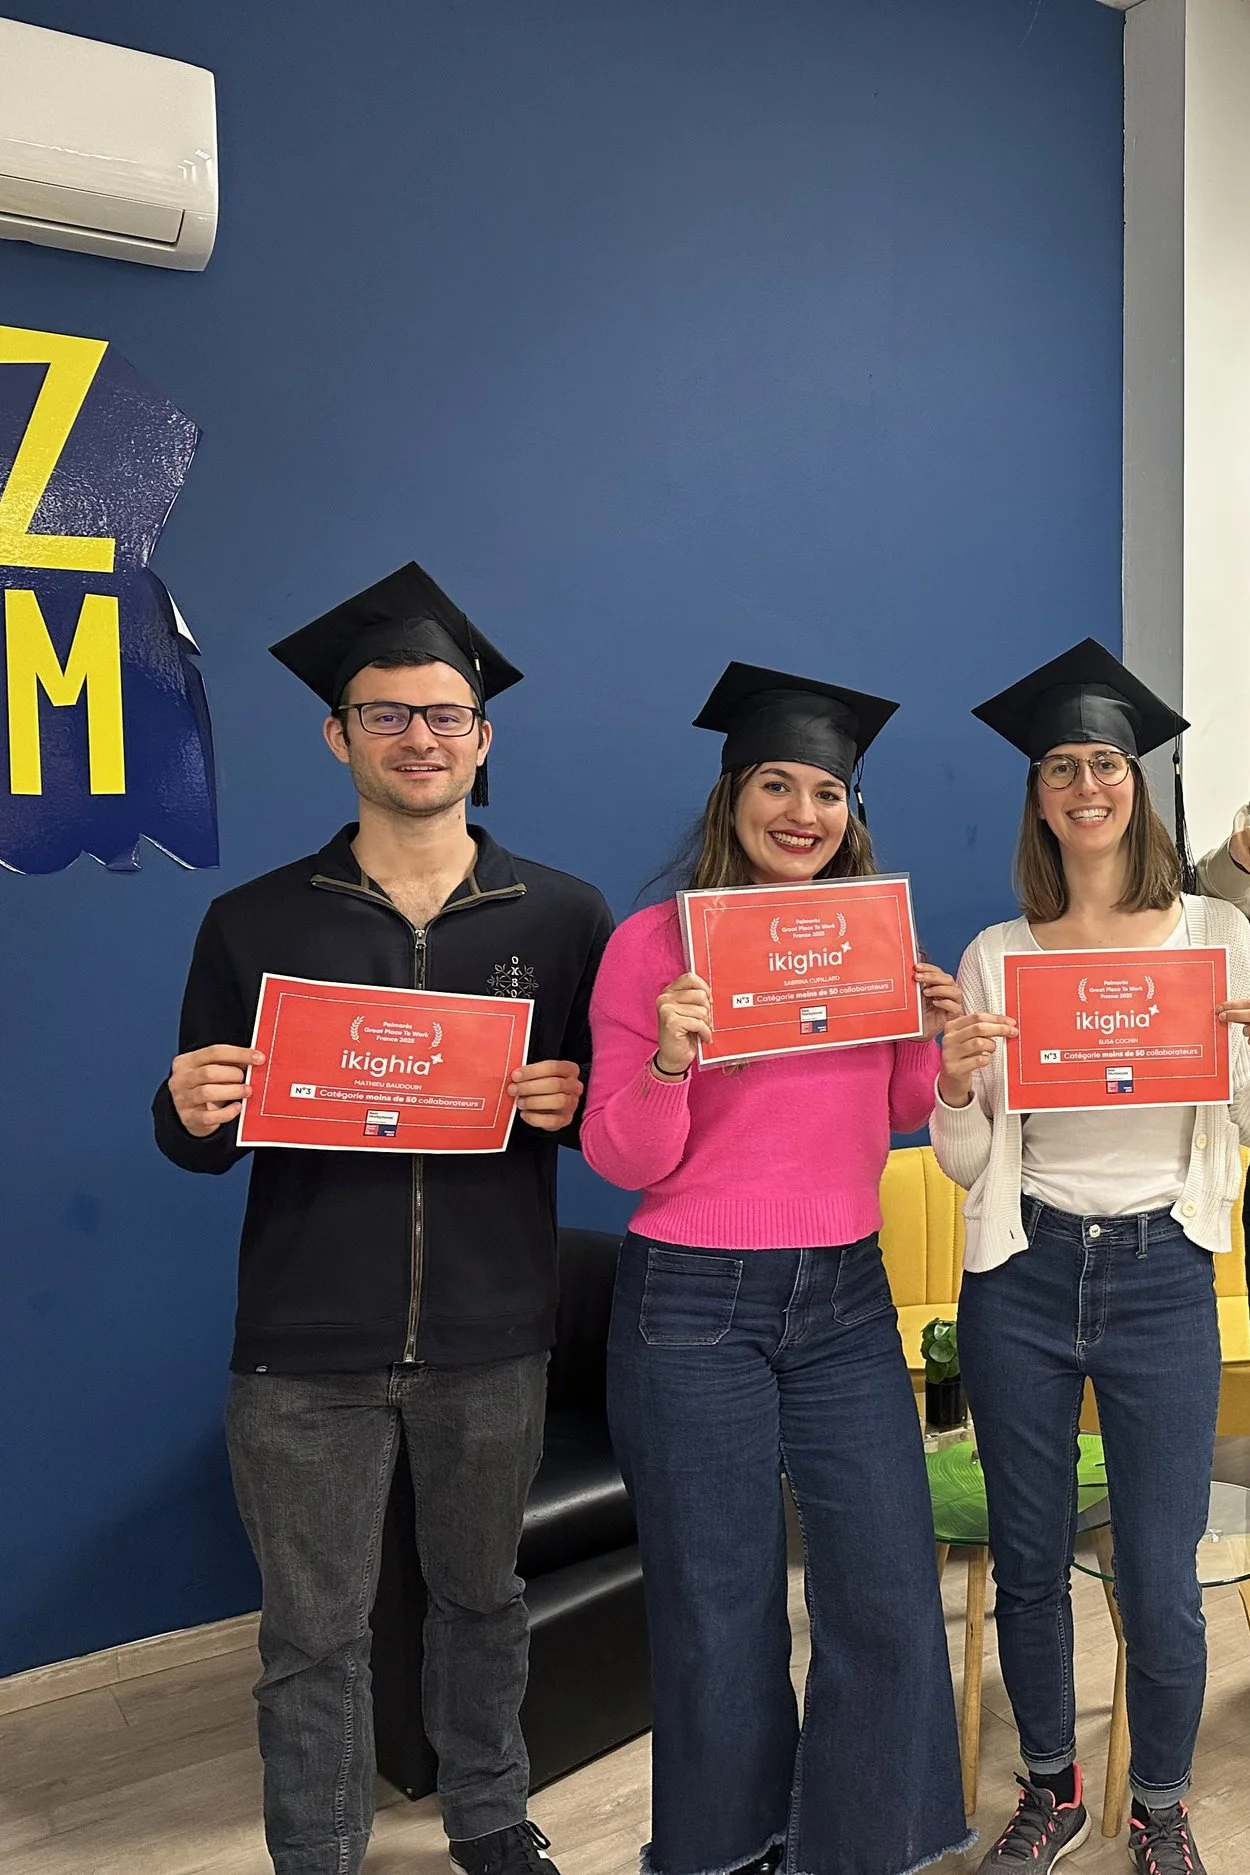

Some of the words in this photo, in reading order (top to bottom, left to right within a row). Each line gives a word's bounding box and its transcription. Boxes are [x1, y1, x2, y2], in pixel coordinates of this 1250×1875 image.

[4, 589, 126, 795] M
[768, 947, 843, 975] ikighia
[736, 996, 750, 1004] N°3
[756, 993, 794, 1003] Catégorie
[795, 990, 817, 999] moins
[818, 989, 828, 997] de
[829, 987, 839, 996] 50
[839, 983, 889, 994] collaborateurs
[1075, 1009, 1150, 1035] ikighia
[341, 1049, 431, 1077] ikighia
[1044, 1052, 1058, 1060] N°3
[1064, 1051, 1101, 1061] Catégorie
[1102, 1050, 1124, 1058] moins
[1124, 1050, 1134, 1058] de
[1135, 1049, 1145, 1057] 50
[1146, 1048, 1198, 1057] collaborateurs
[354, 1079, 384, 1087] MATHIEU
[295, 1087, 311, 1095] N°3
[319, 1089, 363, 1101] Catégorie
[365, 1093, 391, 1102] moins
[393, 1094, 404, 1103] de
[405, 1096, 417, 1104] 50
[418, 1097, 479, 1107] collaborateurs
